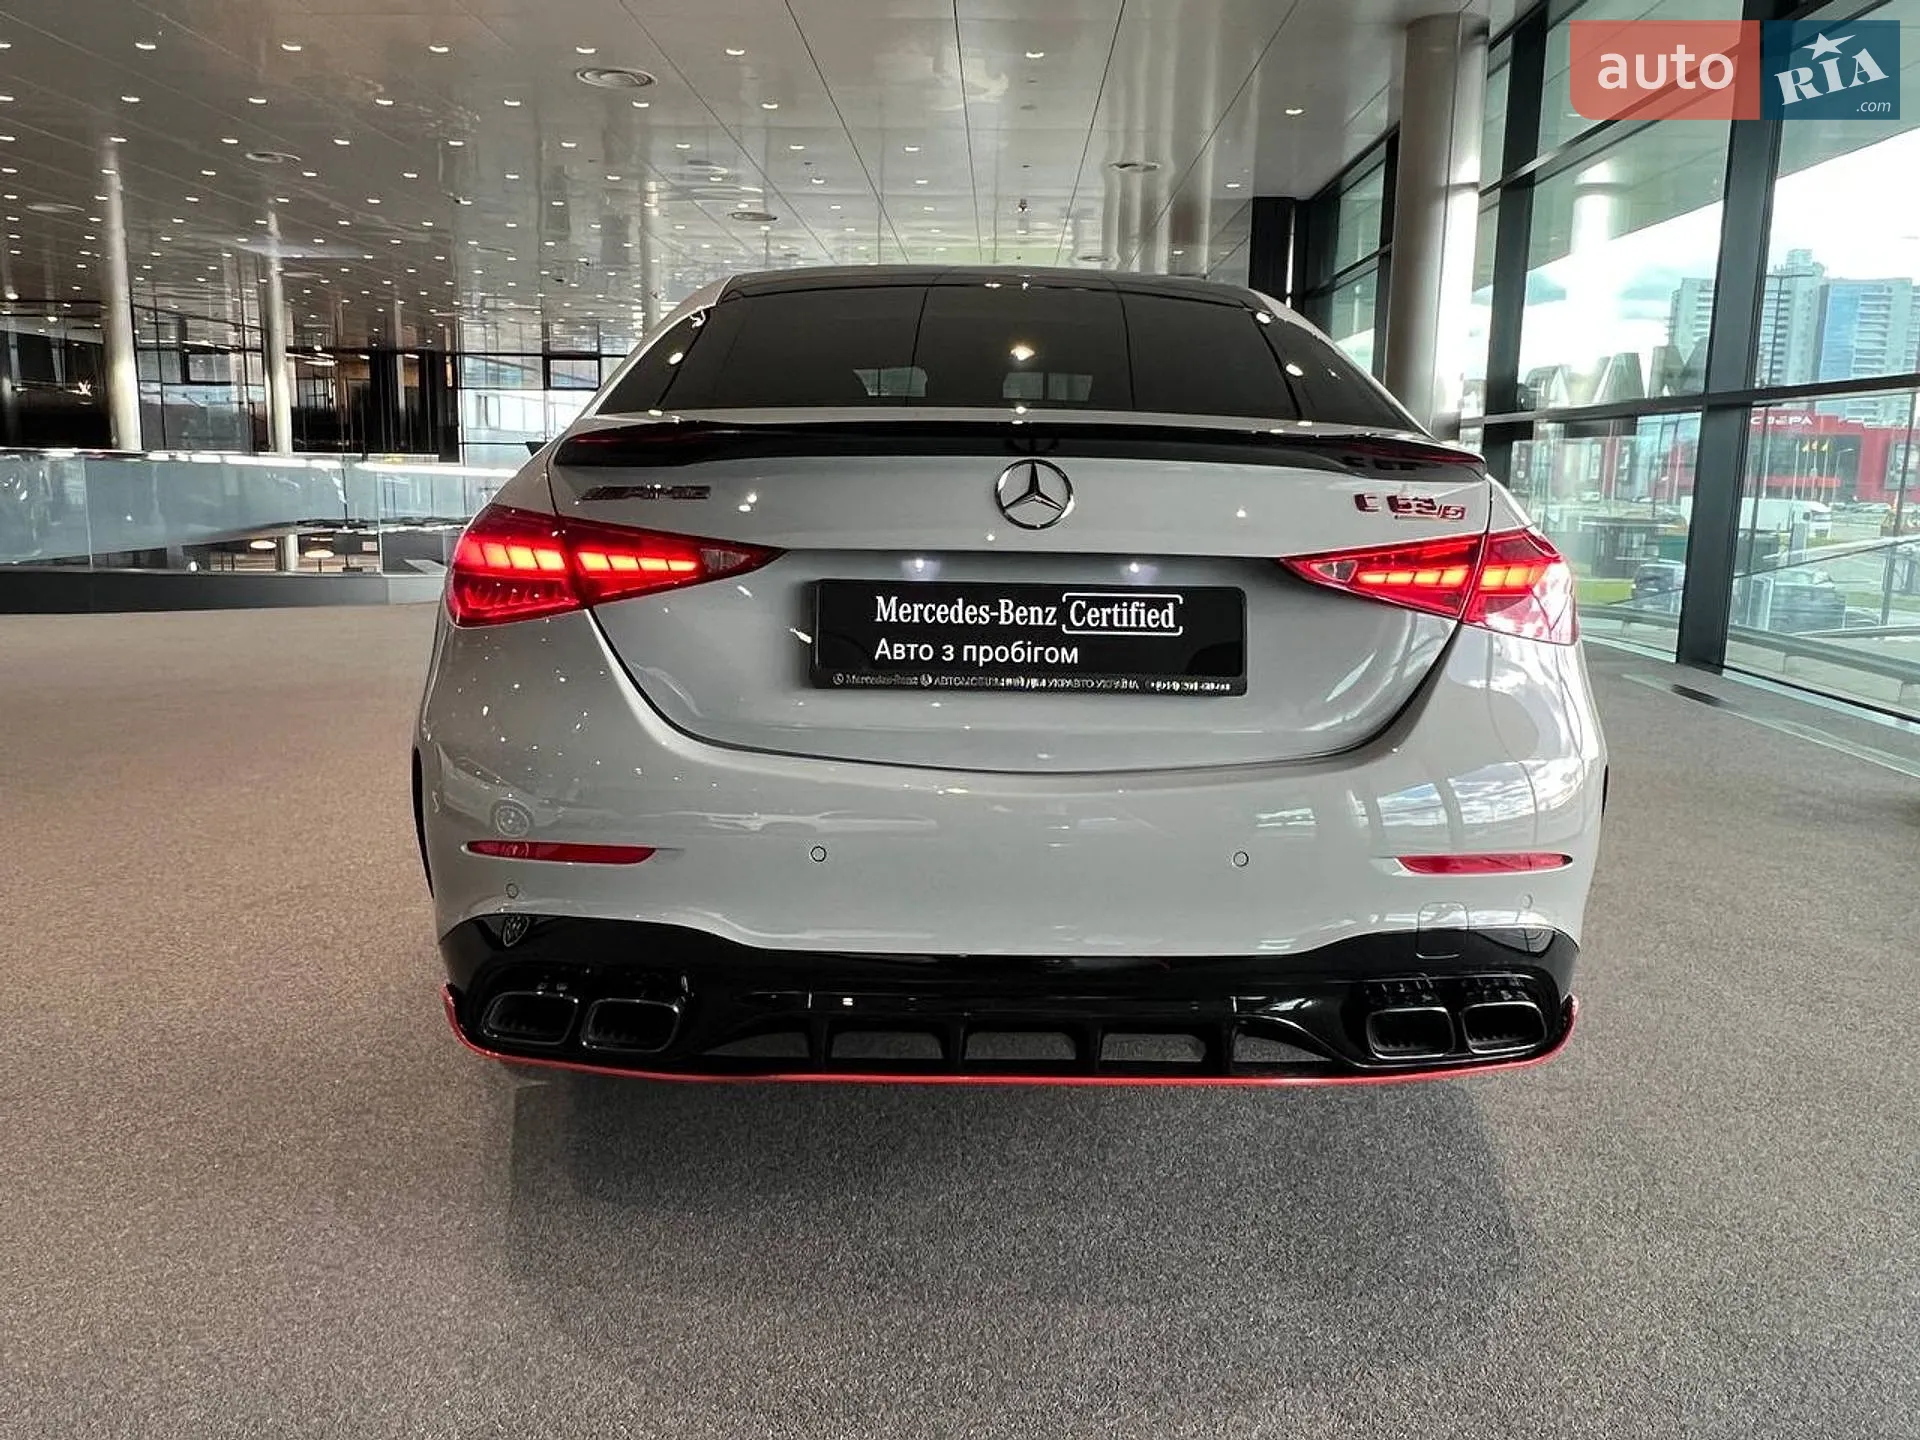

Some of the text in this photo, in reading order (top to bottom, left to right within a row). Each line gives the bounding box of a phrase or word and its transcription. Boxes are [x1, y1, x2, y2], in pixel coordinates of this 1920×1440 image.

[875, 595, 1175, 628] Mercedes-Benz Certified
[875, 638, 1079, 667] Авто з пробігом
